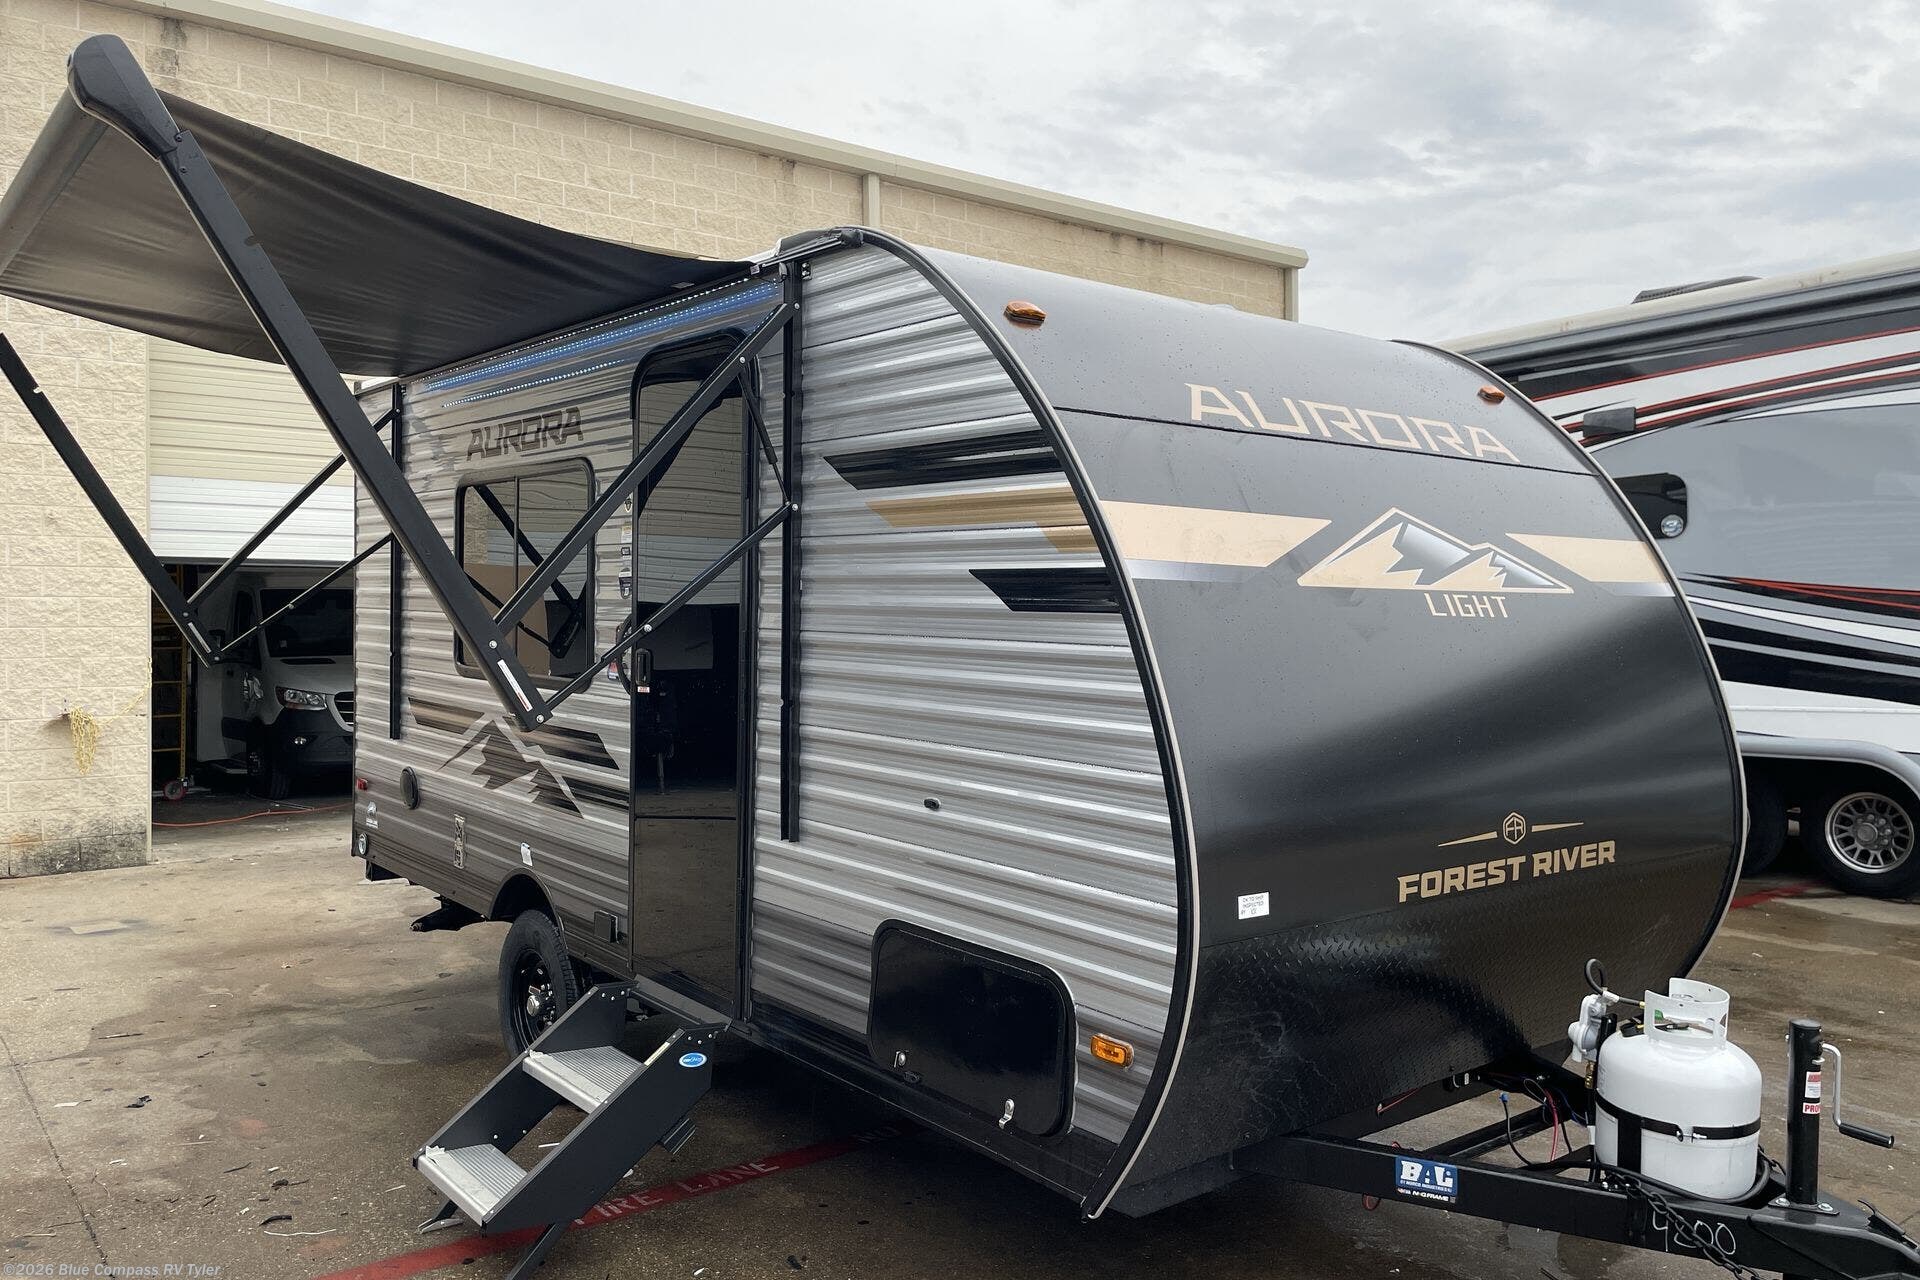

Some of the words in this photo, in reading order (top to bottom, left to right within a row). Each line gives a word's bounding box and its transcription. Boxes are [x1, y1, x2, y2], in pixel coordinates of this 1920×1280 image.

[467, 406, 584, 461] AURORA
[1184, 383, 1521, 463] AURORA
[1424, 592, 1508, 618] LIGHT
[1397, 855, 1526, 903] FOREST
[1532, 840, 1616, 877] RIVER
[574, 1190, 664, 1225] IRE
[676, 1158, 780, 1194] LANE
